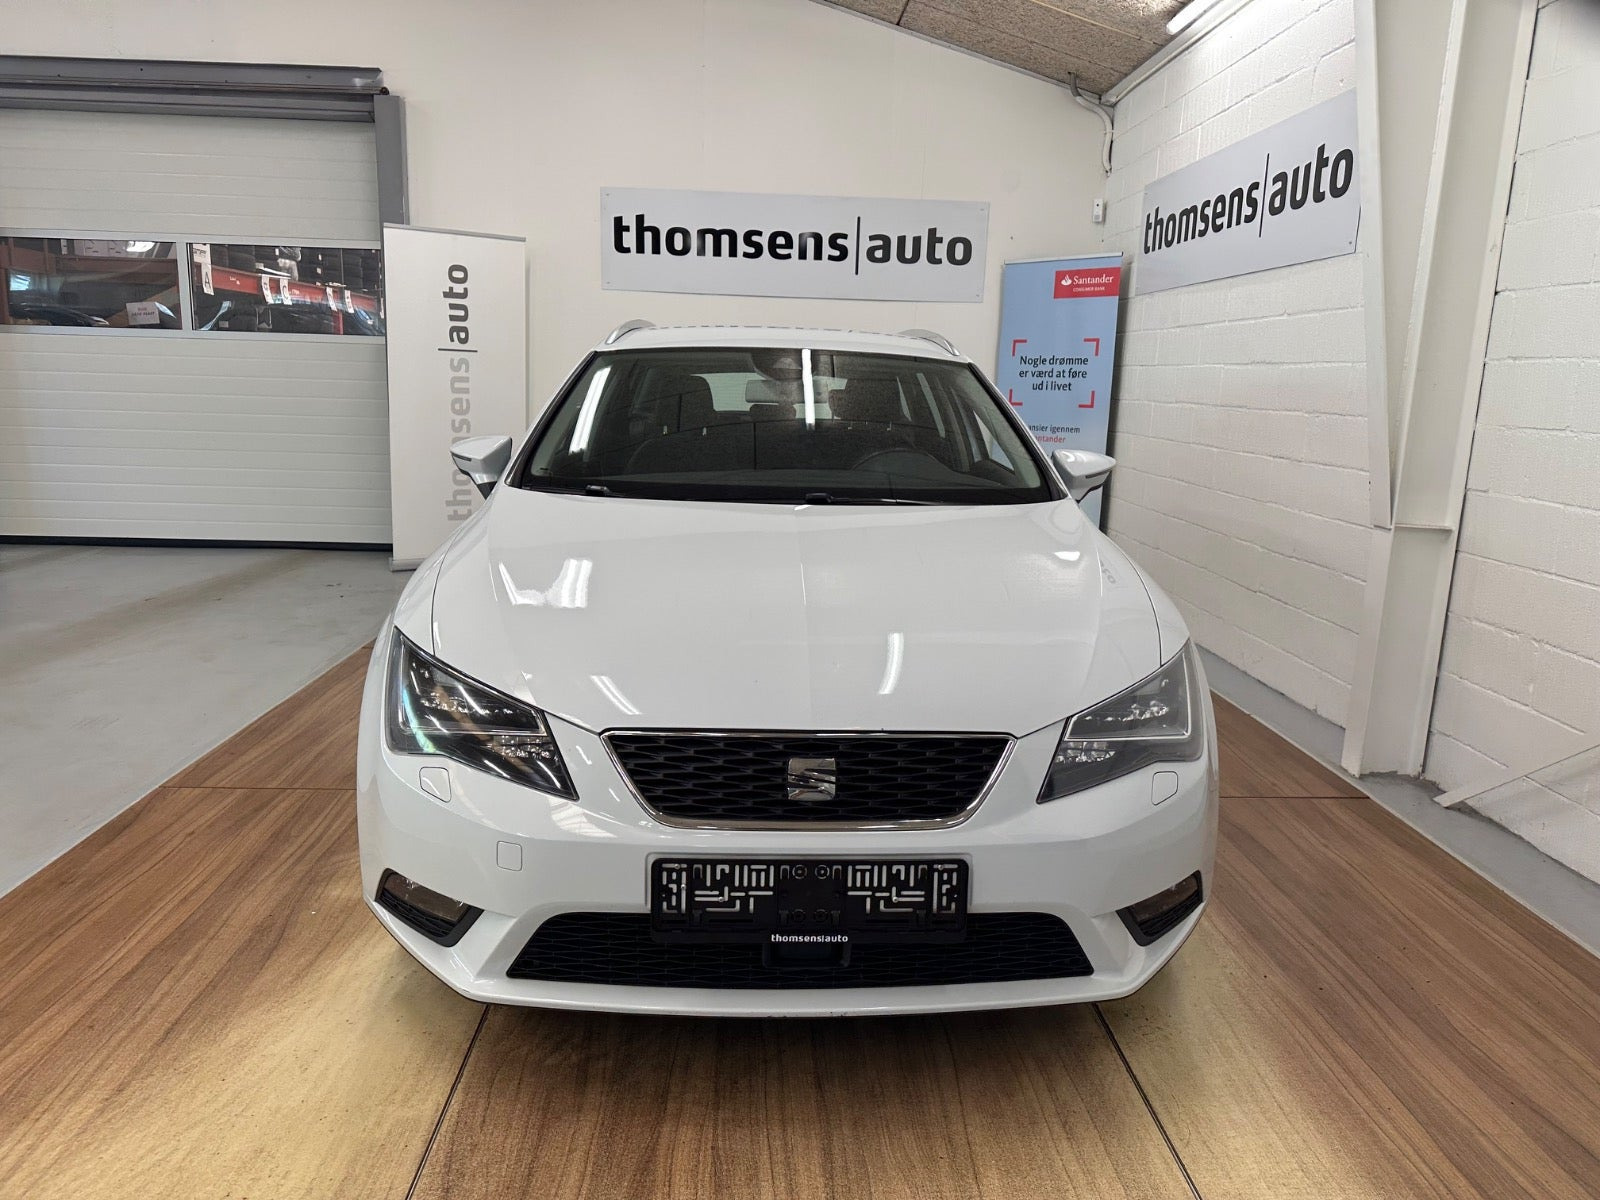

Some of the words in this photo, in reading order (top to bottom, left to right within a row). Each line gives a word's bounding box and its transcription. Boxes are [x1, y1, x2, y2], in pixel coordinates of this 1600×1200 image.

[1073, 274, 1114, 285] Santander
[1019, 355, 1047, 367] Nogle
[1048, 355, 1089, 366] drømme
[1018, 369, 1029, 378] er
[1030, 366, 1053, 378] værd
[1055, 368, 1066, 378] at
[1067, 367, 1087, 380] føre
[1032, 379, 1044, 391] ud
[1051, 380, 1072, 391] livet
[1049, 424, 1081, 435] igennem
[1035, 435, 1066, 443] ntander
